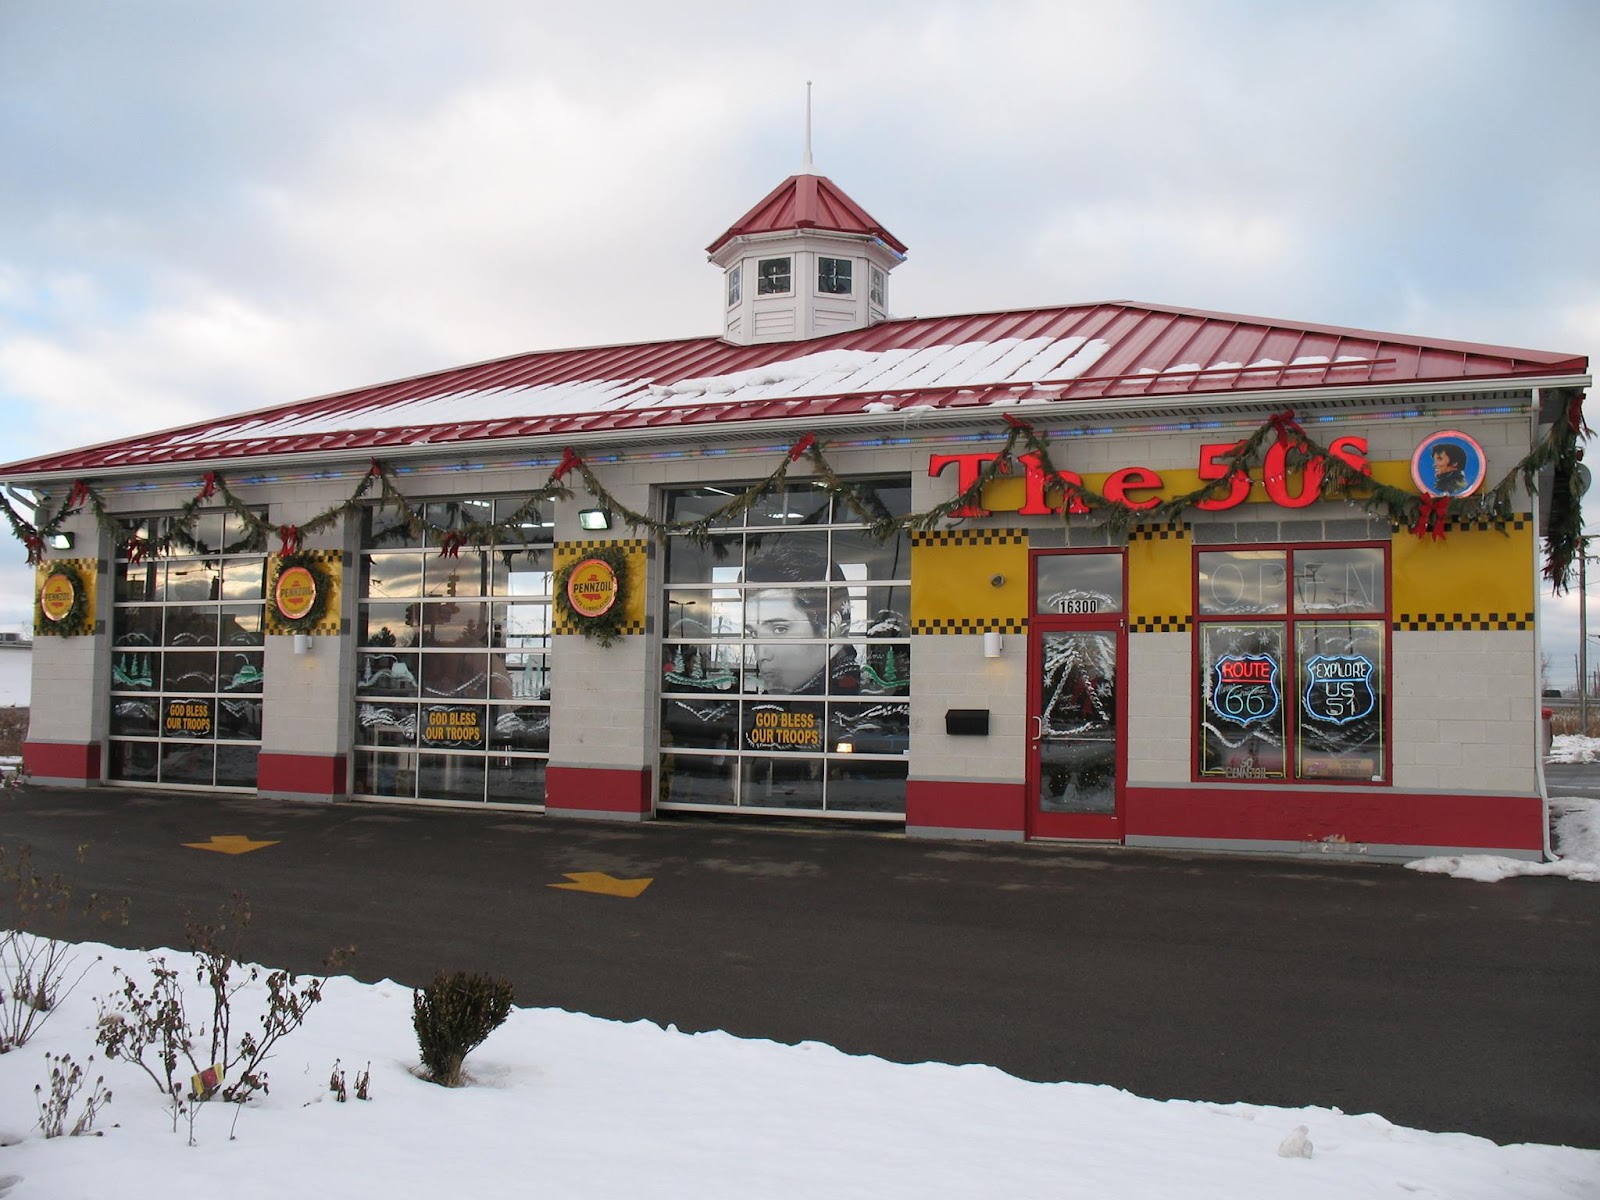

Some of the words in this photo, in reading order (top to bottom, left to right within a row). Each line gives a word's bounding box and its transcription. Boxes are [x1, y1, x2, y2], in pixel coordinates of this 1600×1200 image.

[928, 450, 1164, 518] The
[574, 581, 612, 593] PENNZOIL
[1211, 558, 1375, 607] OPEN
[1060, 600, 1097, 614] 16300
[1222, 661, 1271, 678] ROUTE
[1316, 662, 1367, 679] EXPLORE
[1325, 682, 1355, 698] US
[1225, 684, 1265, 715] 66
[1325, 697, 1356, 716] 51
[170, 703, 185, 717] GOD
[186, 705, 208, 717] BLESS
[166, 717, 181, 729] OUR
[183, 718, 211, 731] TROOPS
[429, 712, 448, 725] GOD
[450, 712, 477, 726] BLESS
[756, 712, 778, 727] GOD
[781, 713, 814, 728] BLESS
[426, 727, 444, 740] OUR
[446, 727, 480, 741] TROOPS
[751, 728, 774, 743] OUR
[776, 729, 819, 744] TROOPS
